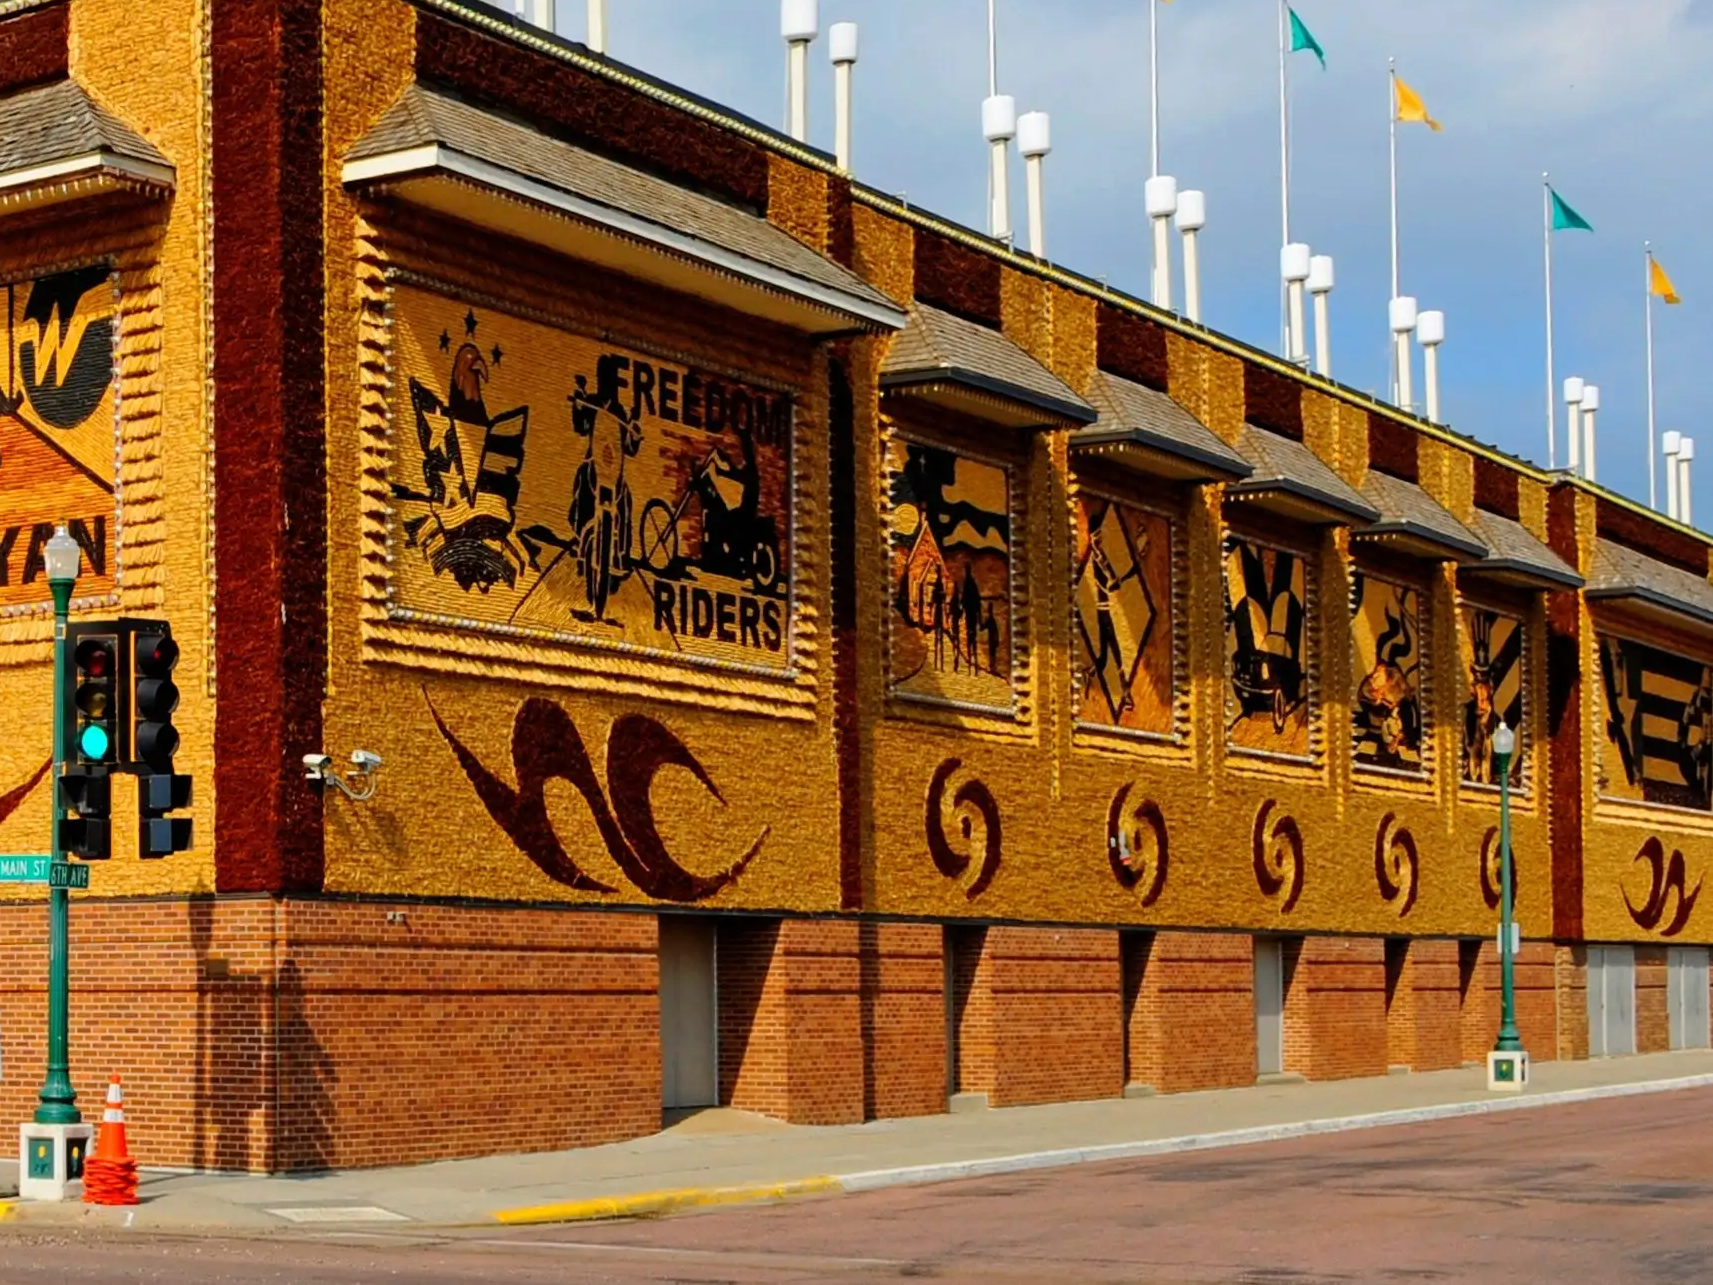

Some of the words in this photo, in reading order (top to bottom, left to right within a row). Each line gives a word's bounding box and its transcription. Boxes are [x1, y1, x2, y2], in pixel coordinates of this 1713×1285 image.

[654, 580, 781, 651] RIDERS
[1, 860, 27, 876] MAIN
[33, 860, 46, 876] ST
[51, 866, 67, 885] 6TH
[70, 867, 87, 886] AVE
